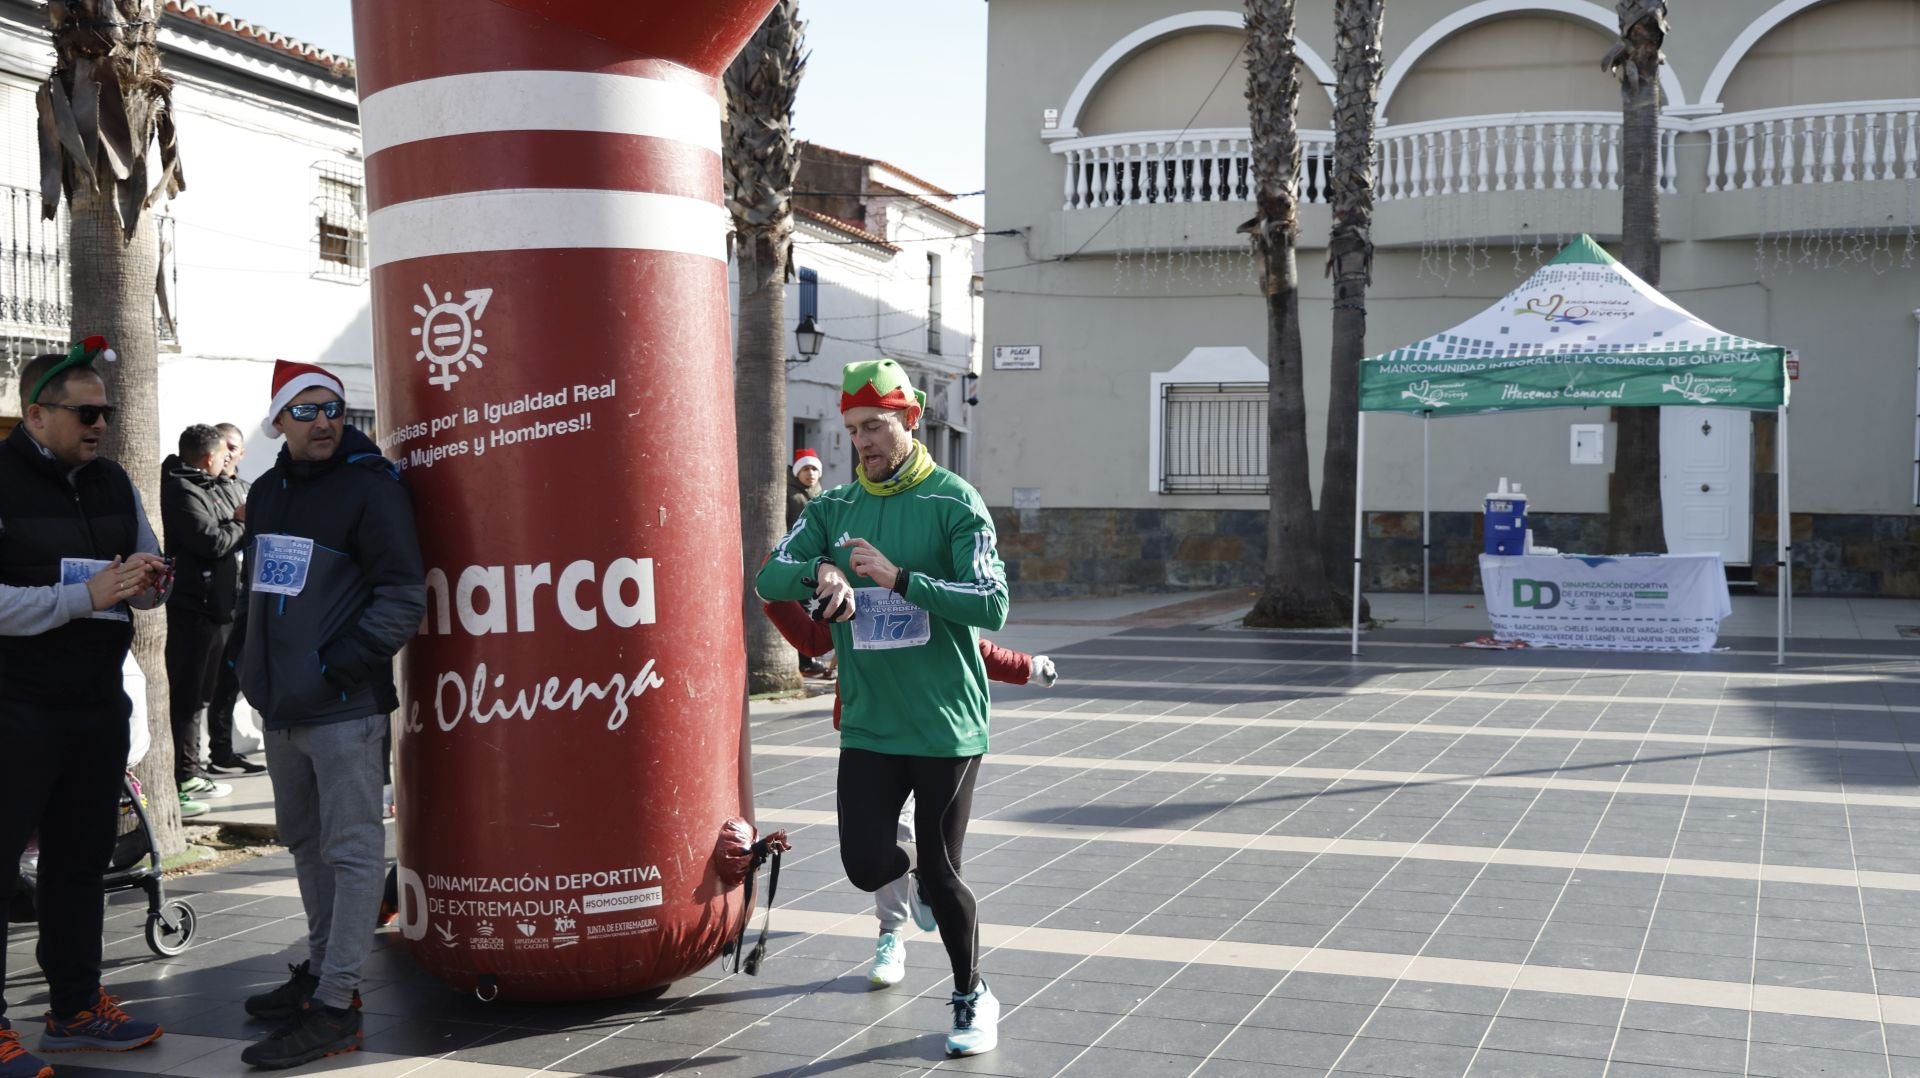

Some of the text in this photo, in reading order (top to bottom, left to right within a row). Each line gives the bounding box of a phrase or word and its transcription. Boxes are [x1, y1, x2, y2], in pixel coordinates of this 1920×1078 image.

[1379, 352, 1761, 374] MANCOMUNIDAD INTEGRAL DE LA COMARCA DE OLIVENZA
[1563, 382, 1626, 399] Comarca!
[432, 413, 458, 438] por
[463, 407, 479, 424] la
[484, 388, 568, 424] Igualdad
[573, 379, 616, 401] Real
[410, 440, 469, 468] Mujeres
[474, 435, 485, 456] y
[490, 412, 592, 448] Hombres!!
[261, 558, 297, 585] 83
[870, 613, 912, 641] 17
[435, 658, 665, 732] Olivenza
[428, 864, 662, 893] DINAMIZACIÓN DEPORTIVA
[429, 897, 581, 917] DE EXTREMADURA
[585, 891, 661, 909] #SOMOSDEPORTE
[586, 918, 658, 936] JUNTA DE EXTREMADURA
